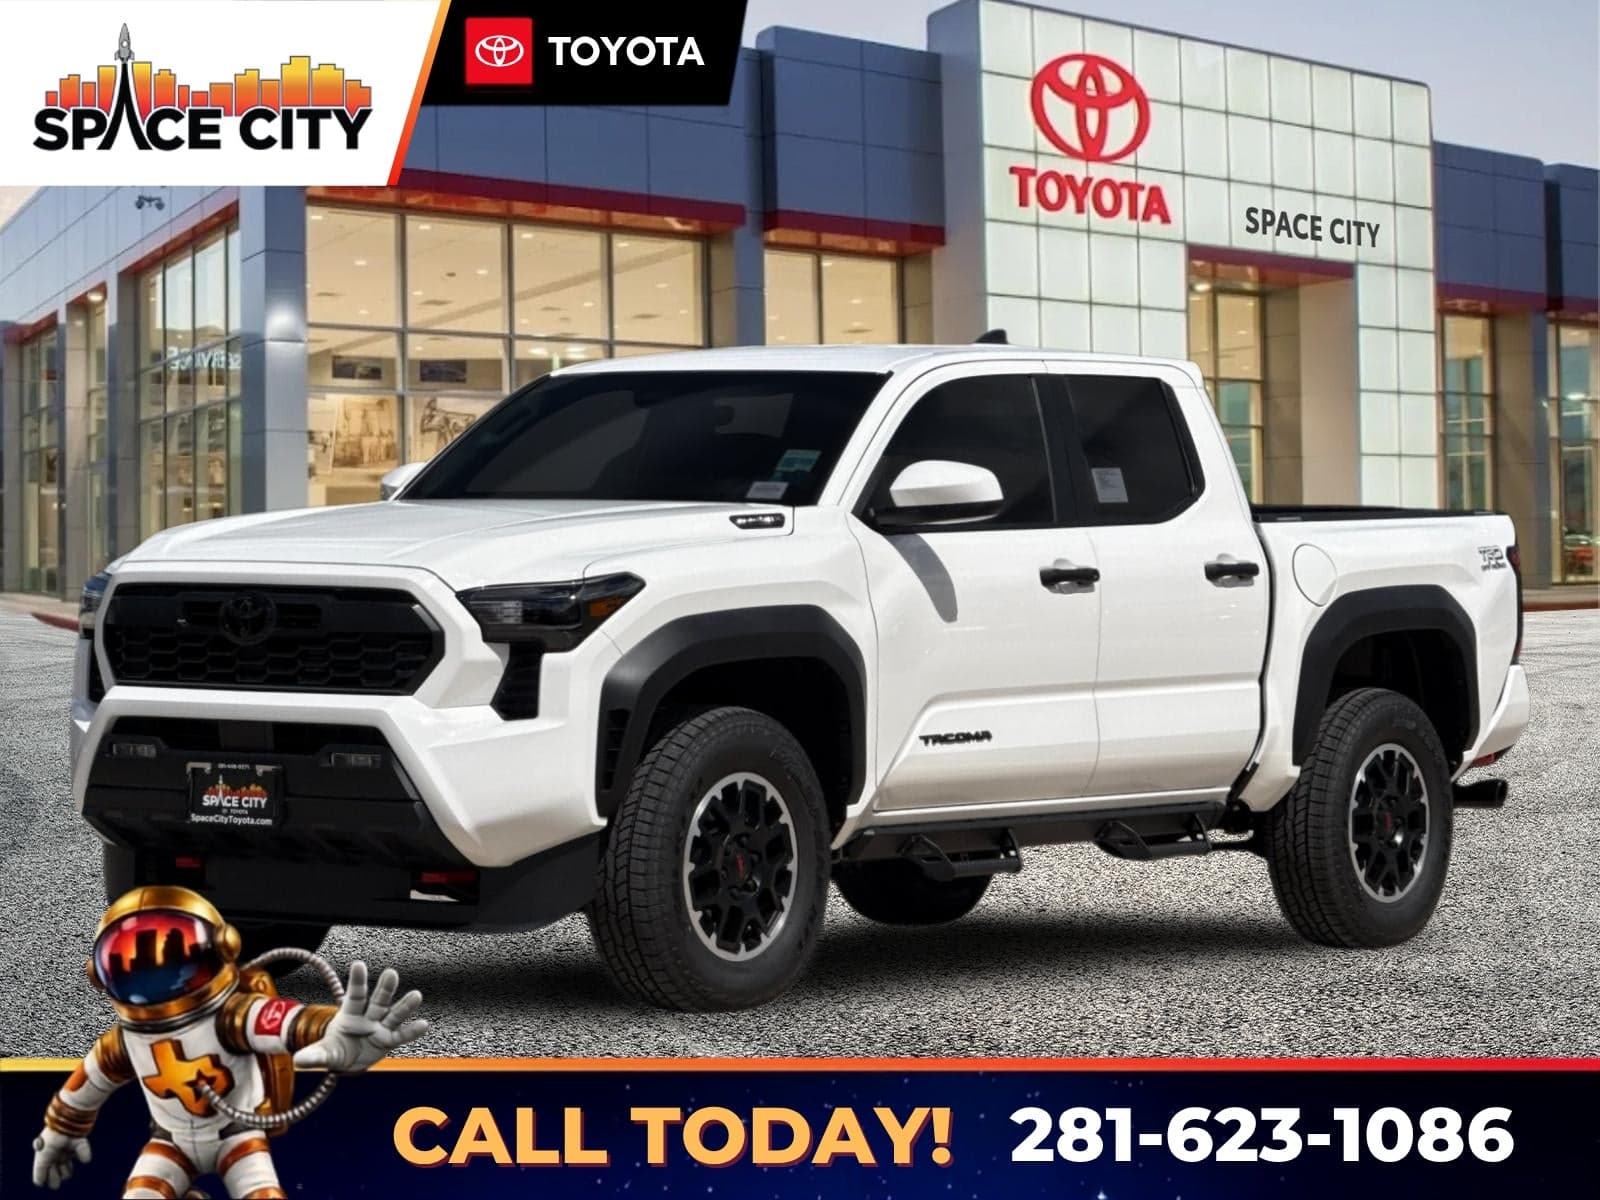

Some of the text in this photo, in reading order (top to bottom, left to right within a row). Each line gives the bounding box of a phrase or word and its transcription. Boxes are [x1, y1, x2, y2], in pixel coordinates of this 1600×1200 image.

[1009, 166, 1171, 225] TOYOTA
[1245, 206, 1380, 248] SPACE CITY
[918, 730, 993, 747] TACOMA
[202, 793, 268, 808] SPACE CITY
[190, 812, 273, 826] SpaceCityToyota.com
